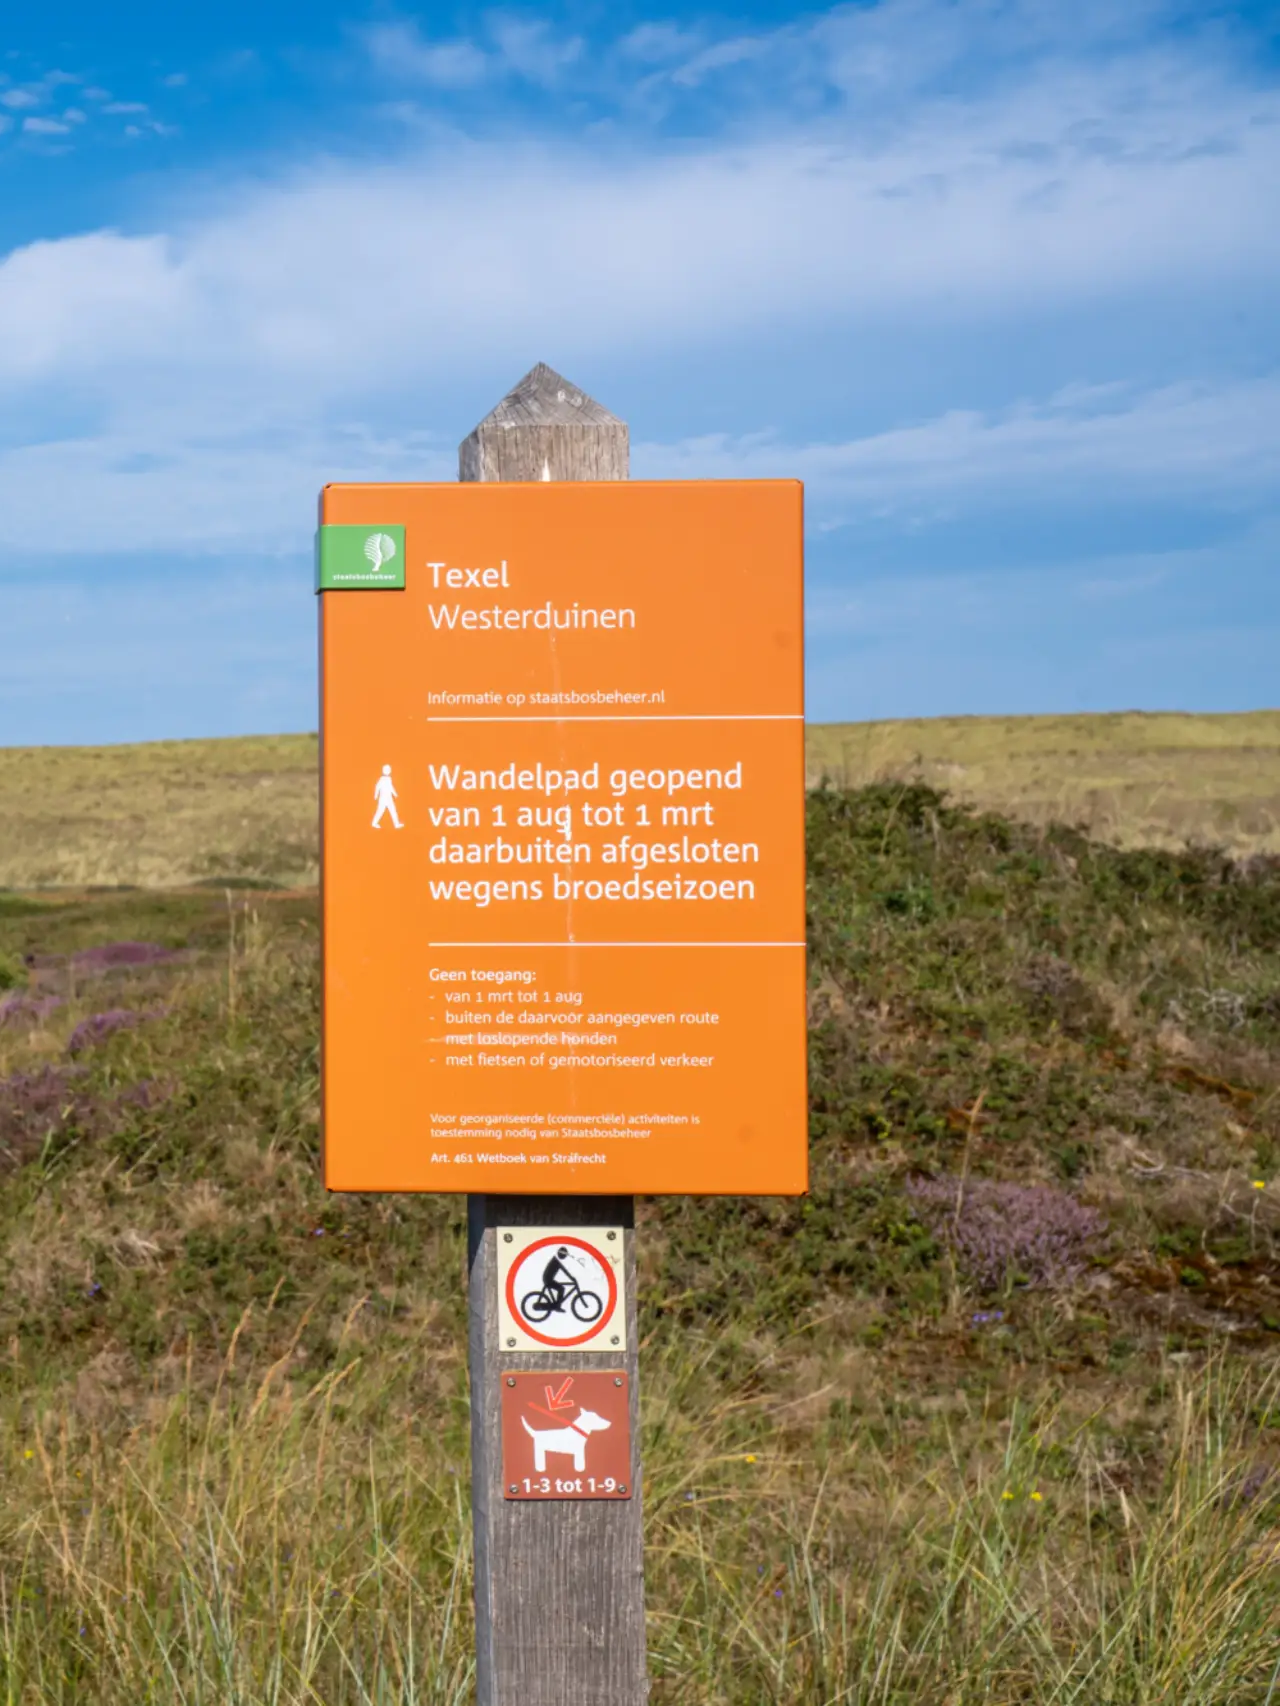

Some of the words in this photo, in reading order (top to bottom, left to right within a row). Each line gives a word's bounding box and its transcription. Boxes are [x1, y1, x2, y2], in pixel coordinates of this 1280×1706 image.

[426, 560, 510, 588] Texel
[428, 601, 636, 630] Westerduinen
[427, 690, 503, 705] Informatie
[505, 694, 526, 707] op
[529, 690, 665, 705] staatsbosbeheer.nl
[429, 762, 599, 796] Wandelpad
[610, 762, 742, 796] geopend
[428, 806, 480, 827] van
[492, 805, 506, 827] 1
[517, 805, 572, 833] aug
[582, 803, 625, 827] tot
[636, 804, 650, 826] 1
[662, 802, 714, 826] mrt
[429, 838, 591, 864] daarbuiten
[602, 836, 759, 869] afgesloten
[429, 879, 543, 907] wegens
[554, 873, 755, 900] broedseizoen
[429, 968, 467, 981] Geen
[471, 969, 537, 985] toegang:
[445, 991, 471, 1003] van
[476, 991, 484, 1003] 1
[488, 991, 514, 1003] mrt
[517, 990, 538, 1003] tot
[543, 991, 551, 1003] 1
[555, 991, 583, 1006] aug
[445, 1010, 492, 1024] buiten
[496, 1010, 515, 1024] de
[518, 1010, 583, 1024] daarvoor
[587, 1012, 676, 1027] aangegeven
[680, 1012, 719, 1025] route
[445, 1034, 474, 1045] met
[477, 1032, 558, 1048] loslopende
[561, 1032, 617, 1046] honden
[445, 1054, 474, 1066] met
[478, 1052, 526, 1066] fietsen
[530, 1053, 545, 1066] of
[549, 1052, 655, 1069] gemotoriseerd
[660, 1052, 715, 1066] verkeer
[430, 1114, 456, 1124] Voor
[460, 1113, 544, 1126] georganiseerde
[628, 1114, 688, 1124] activiteiten
[692, 1114, 700, 1124] is
[430, 1128, 502, 1140] toestemming
[505, 1128, 536, 1140] nodig
[539, 1129, 559, 1138] van
[561, 1128, 652, 1139] Staatsbosbeheer
[431, 1153, 451, 1163] Art.
[454, 1153, 473, 1164] 461
[476, 1153, 527, 1163] Wetboek
[530, 1154, 549, 1163] van
[522, 1478, 551, 1493] 1-3
[555, 1478, 582, 1493] tot
[587, 1478, 616, 1493] 1-9
